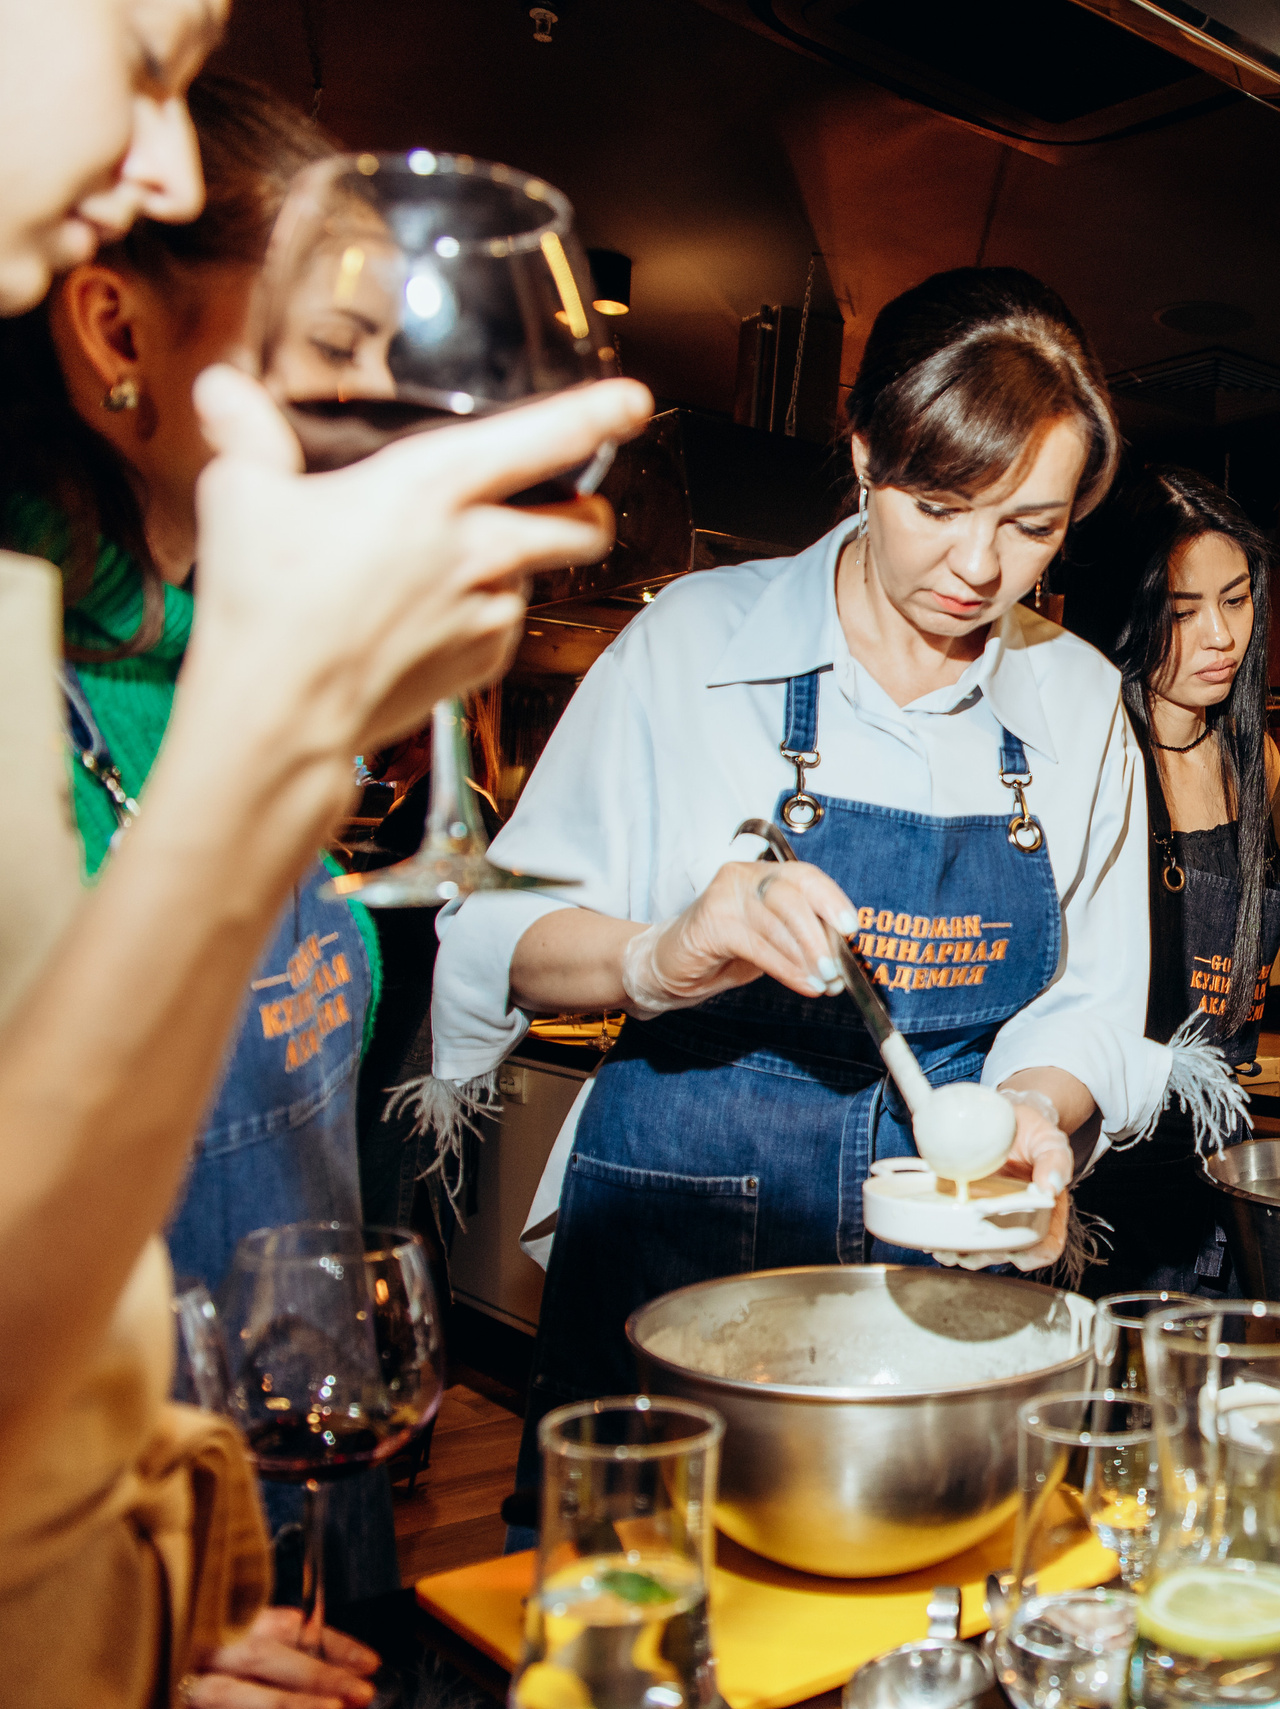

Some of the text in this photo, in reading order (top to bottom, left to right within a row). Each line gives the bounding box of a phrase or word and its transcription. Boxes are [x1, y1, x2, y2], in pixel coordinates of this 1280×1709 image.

[857, 906, 982, 939] GOODMAN
[843, 932, 1009, 965] ЛИНАРНАЯ
[858, 960, 988, 993] АДЕМИЯ
